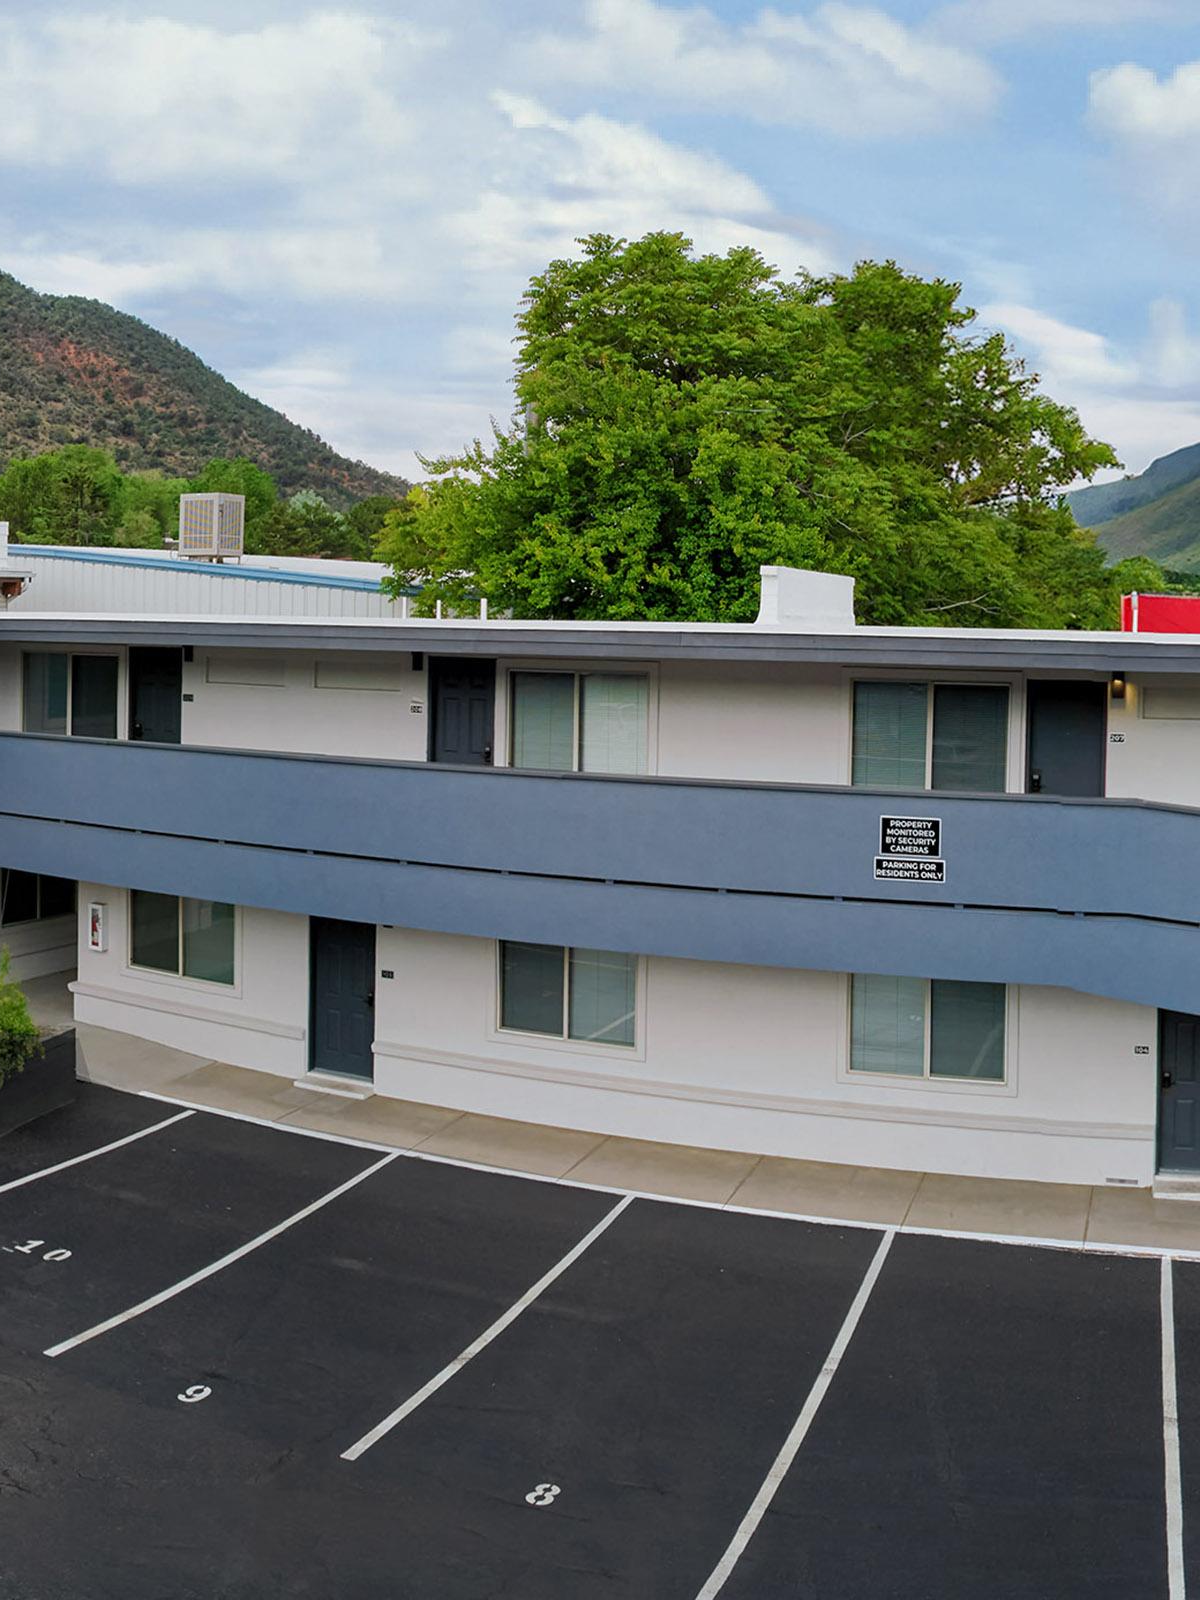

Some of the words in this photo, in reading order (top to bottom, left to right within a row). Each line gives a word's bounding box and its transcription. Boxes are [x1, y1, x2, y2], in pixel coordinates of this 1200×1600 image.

[890, 820, 932, 829] PROPERTY
[886, 828, 935, 838] MONITORED
[885, 836, 897, 844] BY
[898, 837, 936, 846] SECURITY
[890, 845, 929, 854] CAMERAS
[882, 861, 918, 870] PARKING
[919, 863, 937, 871] FOR
[876, 868, 920, 879] RESIDENTS
[920, 871, 943, 880] ONLY
[14, 1239, 73, 1262] 10
[177, 1384, 212, 1403] 9
[525, 1483, 562, 1506] 8
